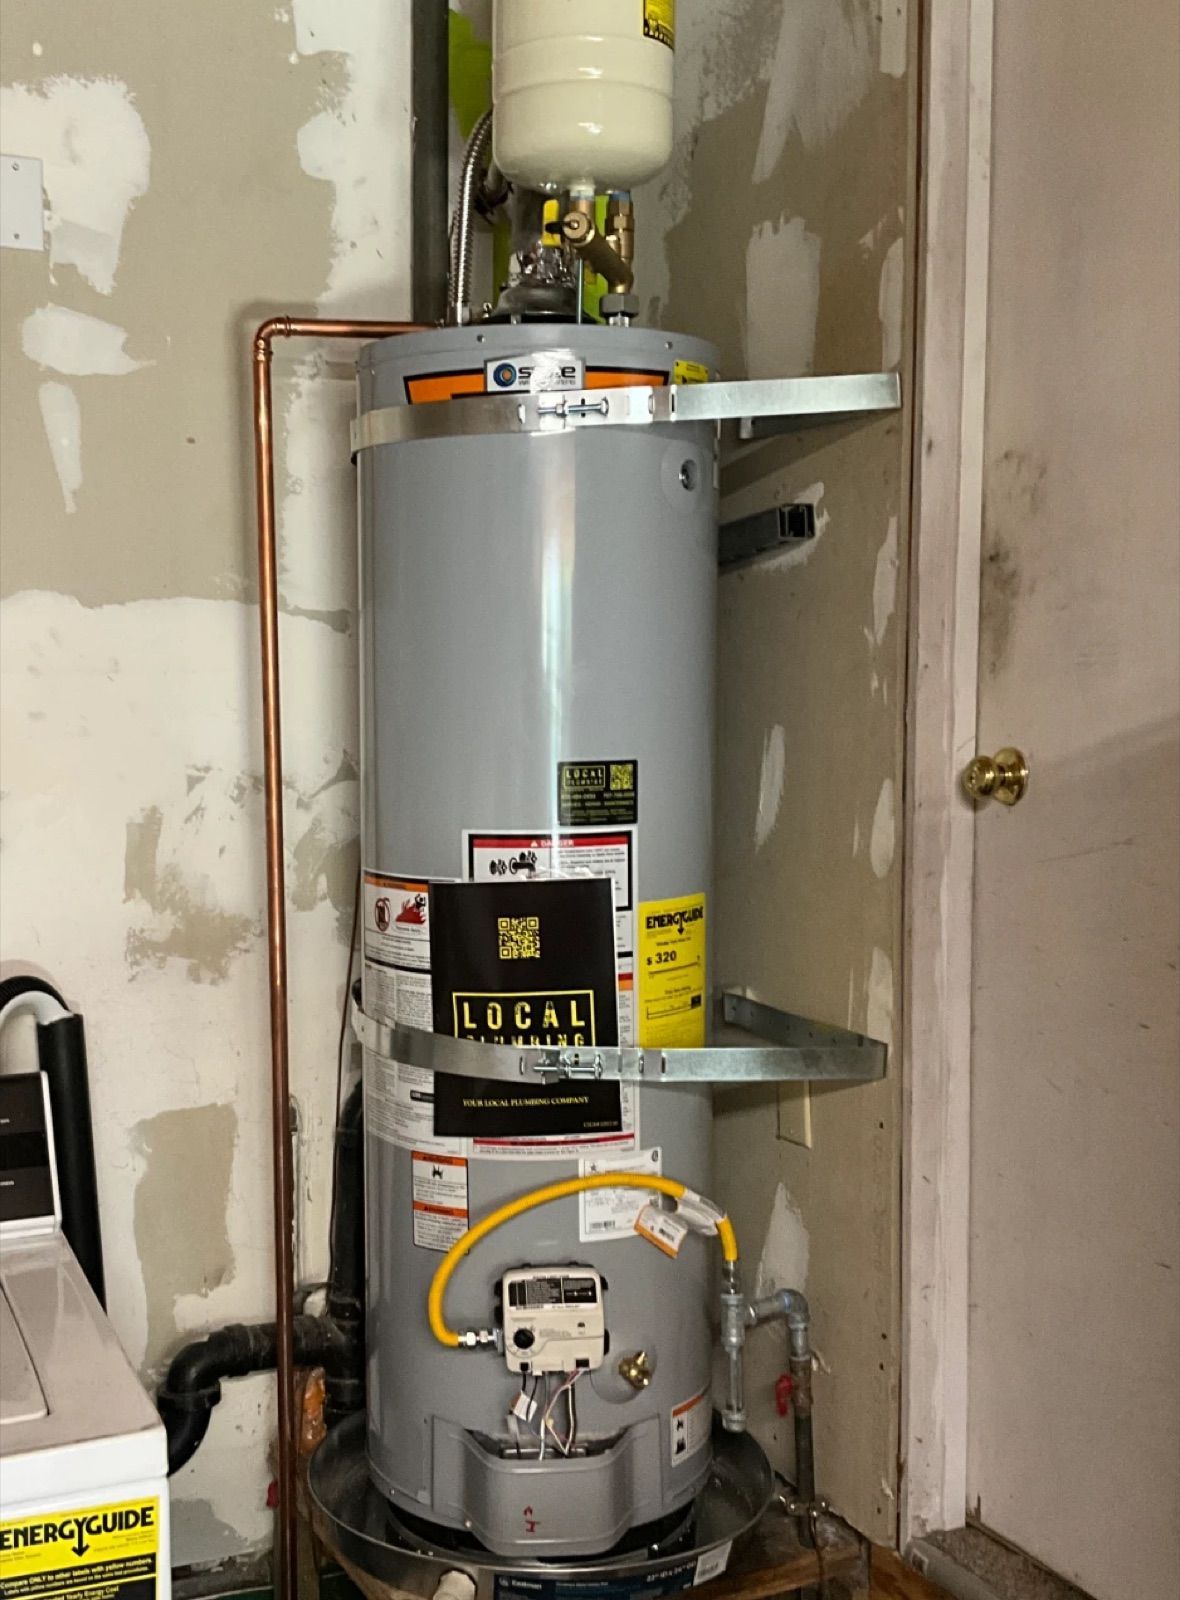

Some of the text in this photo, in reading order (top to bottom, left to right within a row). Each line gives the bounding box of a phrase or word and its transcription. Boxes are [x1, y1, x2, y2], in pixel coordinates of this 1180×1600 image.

[566, 769, 603, 778] LOCAL
[656, 950, 677, 964] 320
[463, 1000, 585, 1030] LOCAL
[463, 1096, 589, 1107] YOUR LOCAL PLUMBING COMPANY
[0, 1506, 154, 1551] ENERGYGUIDE
